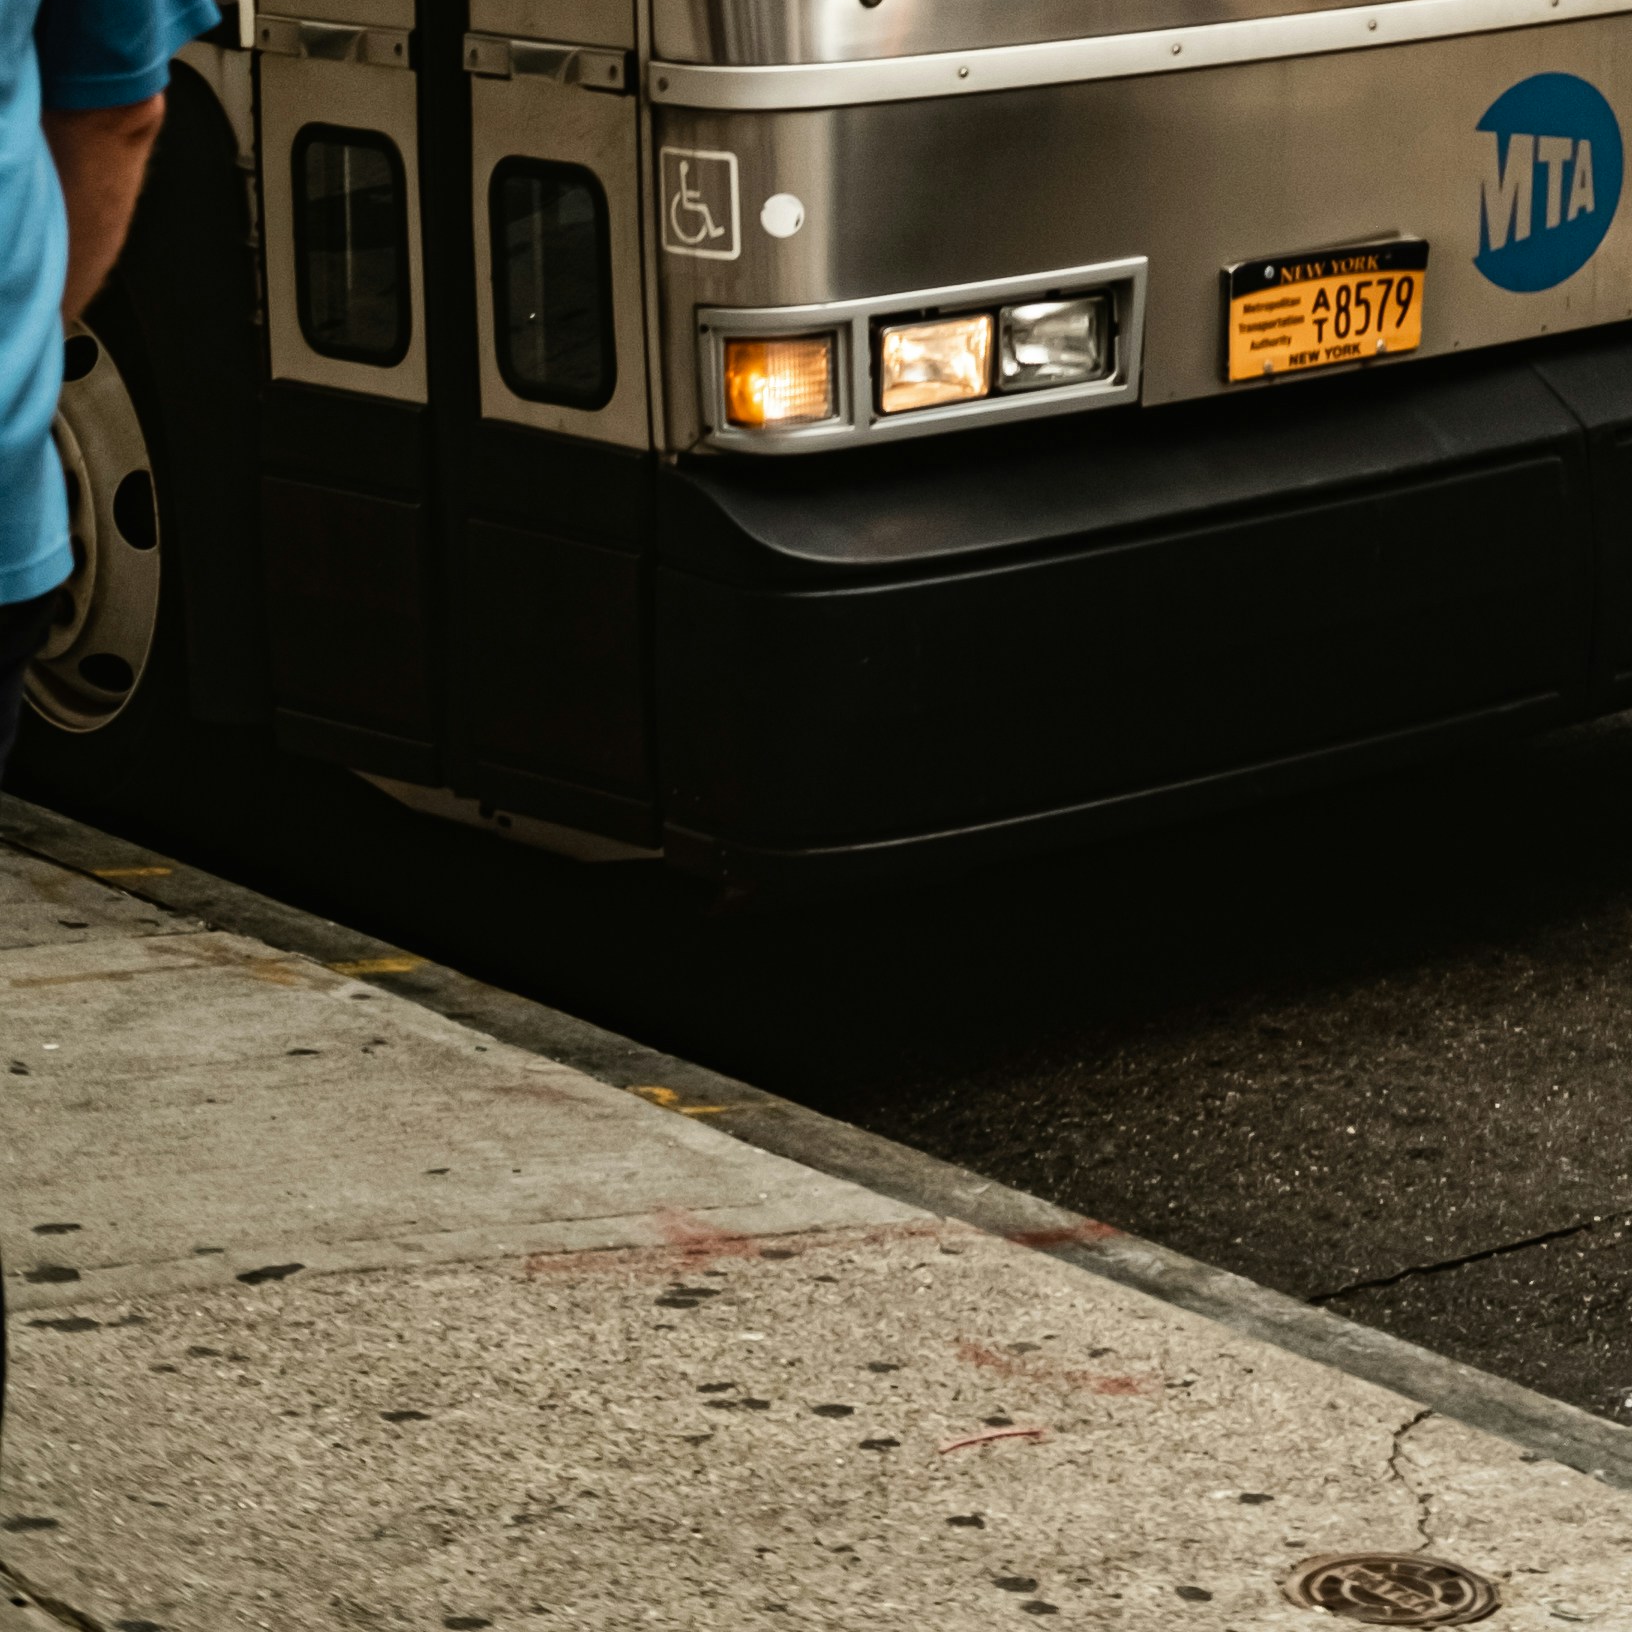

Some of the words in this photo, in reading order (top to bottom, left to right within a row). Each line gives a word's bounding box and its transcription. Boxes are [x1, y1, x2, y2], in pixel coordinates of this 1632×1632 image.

[1476, 130, 1597, 255] MTA
[1280, 261, 1326, 285] NEW
[1331, 254, 1380, 276] YORK
[1243, 296, 1302, 314] Metropolitan
[1239, 314, 1305, 334] Transportation
[1250, 334, 1292, 352] Authority
[1289, 350, 1320, 367] NEW
[1324, 342, 1361, 360] YORK
